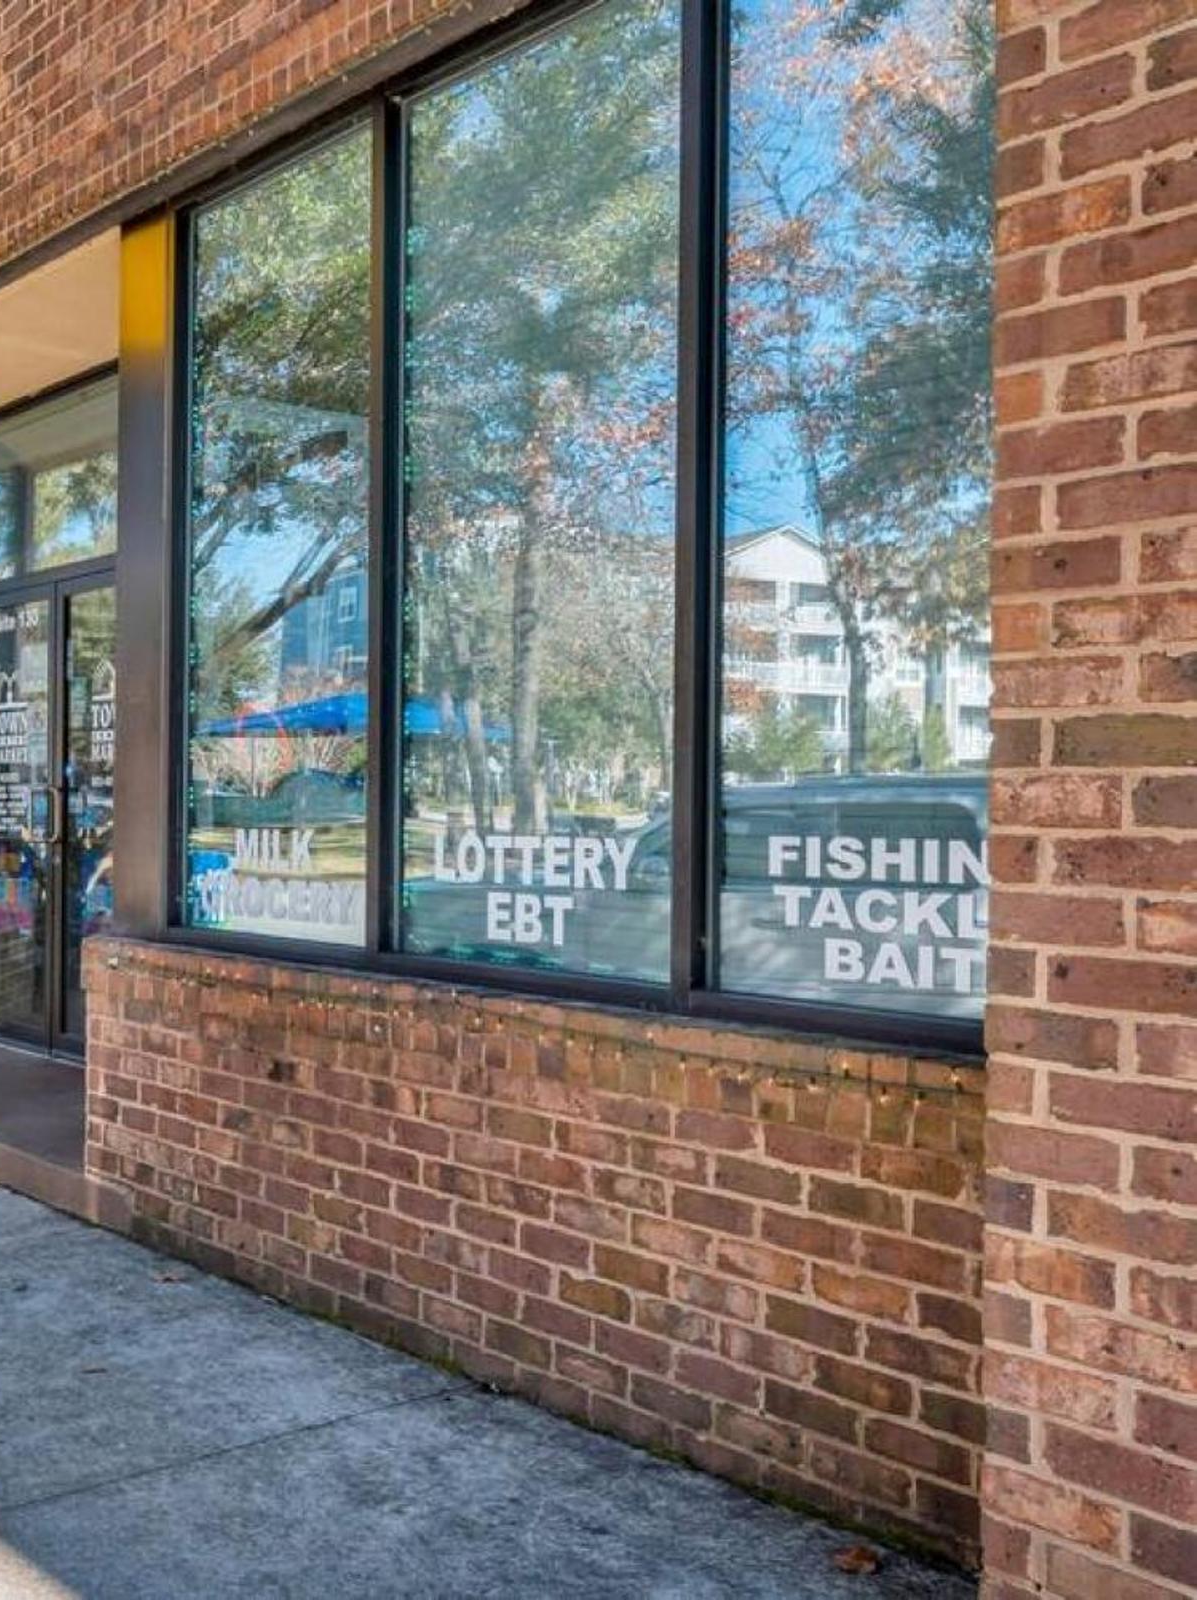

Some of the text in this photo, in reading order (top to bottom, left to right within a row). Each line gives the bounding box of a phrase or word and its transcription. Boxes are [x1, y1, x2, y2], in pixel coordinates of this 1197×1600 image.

[92, 703, 114, 729] TO
[234, 828, 315, 872] MILK
[434, 830, 638, 890] LOTTERY
[202, 870, 362, 927] GROCERY
[486, 892, 575, 946] EBT
[824, 938, 987, 993] BAIT
